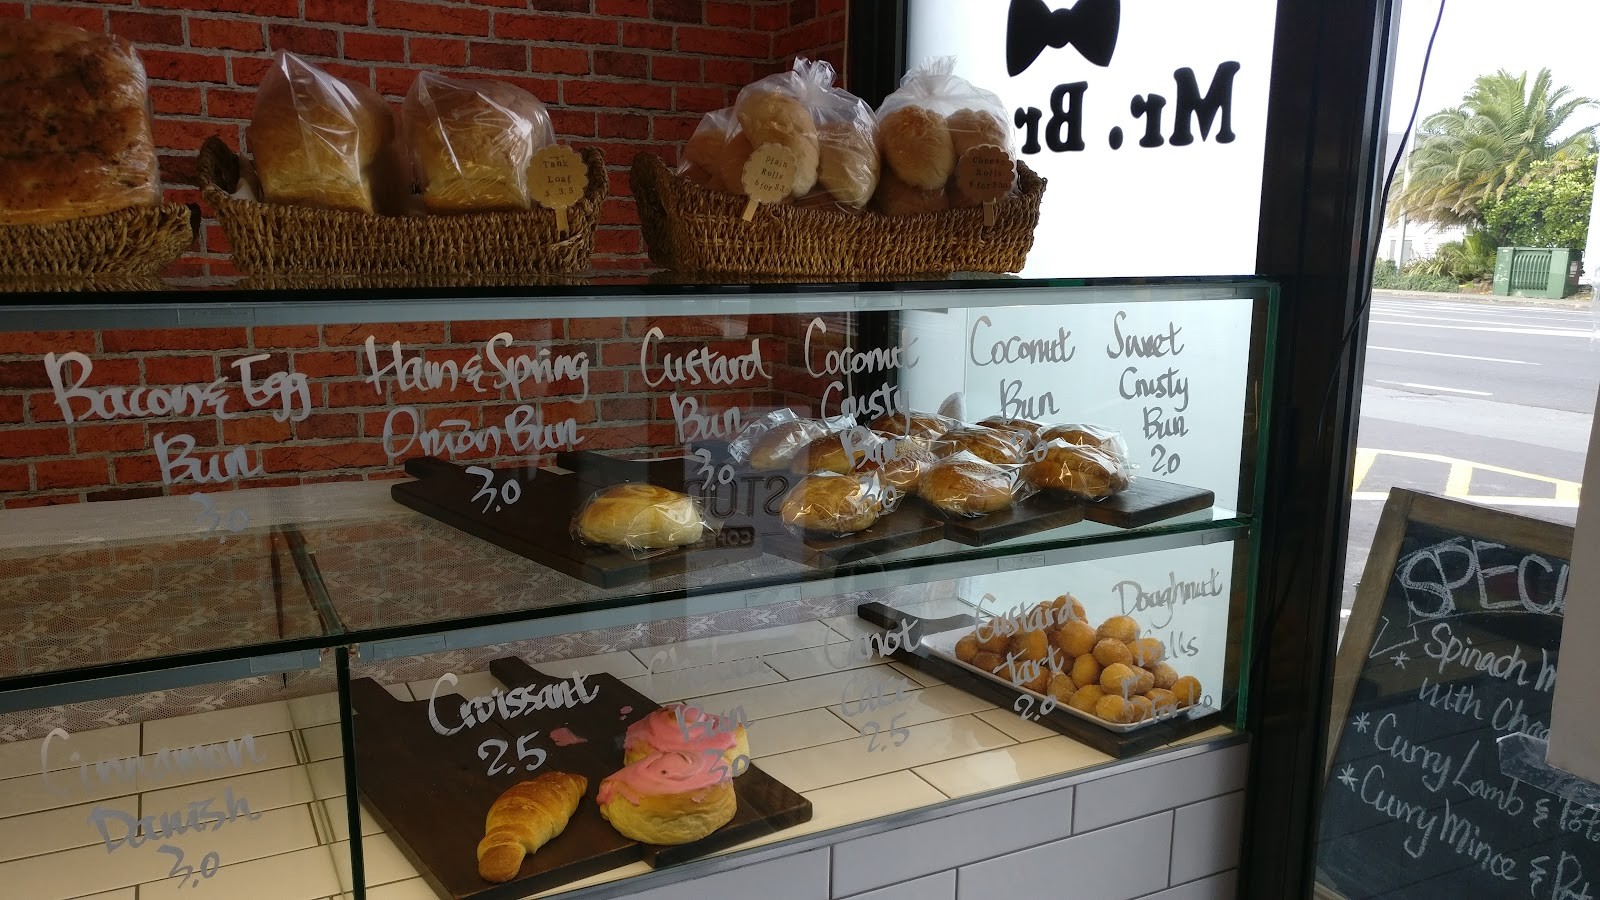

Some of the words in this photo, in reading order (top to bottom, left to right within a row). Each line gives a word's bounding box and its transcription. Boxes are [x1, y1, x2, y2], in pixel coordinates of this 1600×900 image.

[547, 175, 571, 184] Loaf
[761, 168, 784, 180] Rolls
[766, 155, 788, 169] Plain
[640, 326, 773, 388] Custard
[804, 316, 919, 379] Coconut
[970, 315, 1076, 367] Coconut
[1106, 310, 1185, 360] Sweet
[44, 351, 202, 424] Bacon
[365, 335, 458, 395] Ham
[486, 331, 589, 404] Spring
[1119, 366, 1190, 412] Crusty
[669, 391, 751, 444] Bun
[820, 380, 911, 440] Crusty
[1000, 378, 1060, 422] Bun
[1142, 406, 1189, 441] Bun
[383, 405, 502, 458] Onion
[504, 404, 585, 452] Bun
[840, 425, 904, 472] Bun
[153, 431, 262, 486] Bun
[694, 448, 735, 491] 3.0
[1150, 443, 1181, 476] 2.0
[465, 465, 522, 514] 3.0
[1111, 567, 1224, 629] Doughnut
[1395, 538, 1570, 618] SPECI
[975, 592, 1081, 645] Custard
[1424, 622, 1530, 687] Spinach
[428, 671, 600, 737] Croissant
[674, 702, 756, 744] Bun
[1013, 693, 1058, 722] 2.0
[1419, 678, 1484, 721] with
[476, 730, 548, 777] 2.5
[859, 711, 911, 753] 2.5
[41, 727, 268, 796] Cinnamon
[1374, 712, 1451, 793] Curry
[1452, 740, 1525, 817] Lamb
[88, 784, 263, 855] Danish
[1360, 764, 1438, 859] Curry
[1439, 798, 1519, 881] Mince
[157, 843, 221, 890] 3.0
